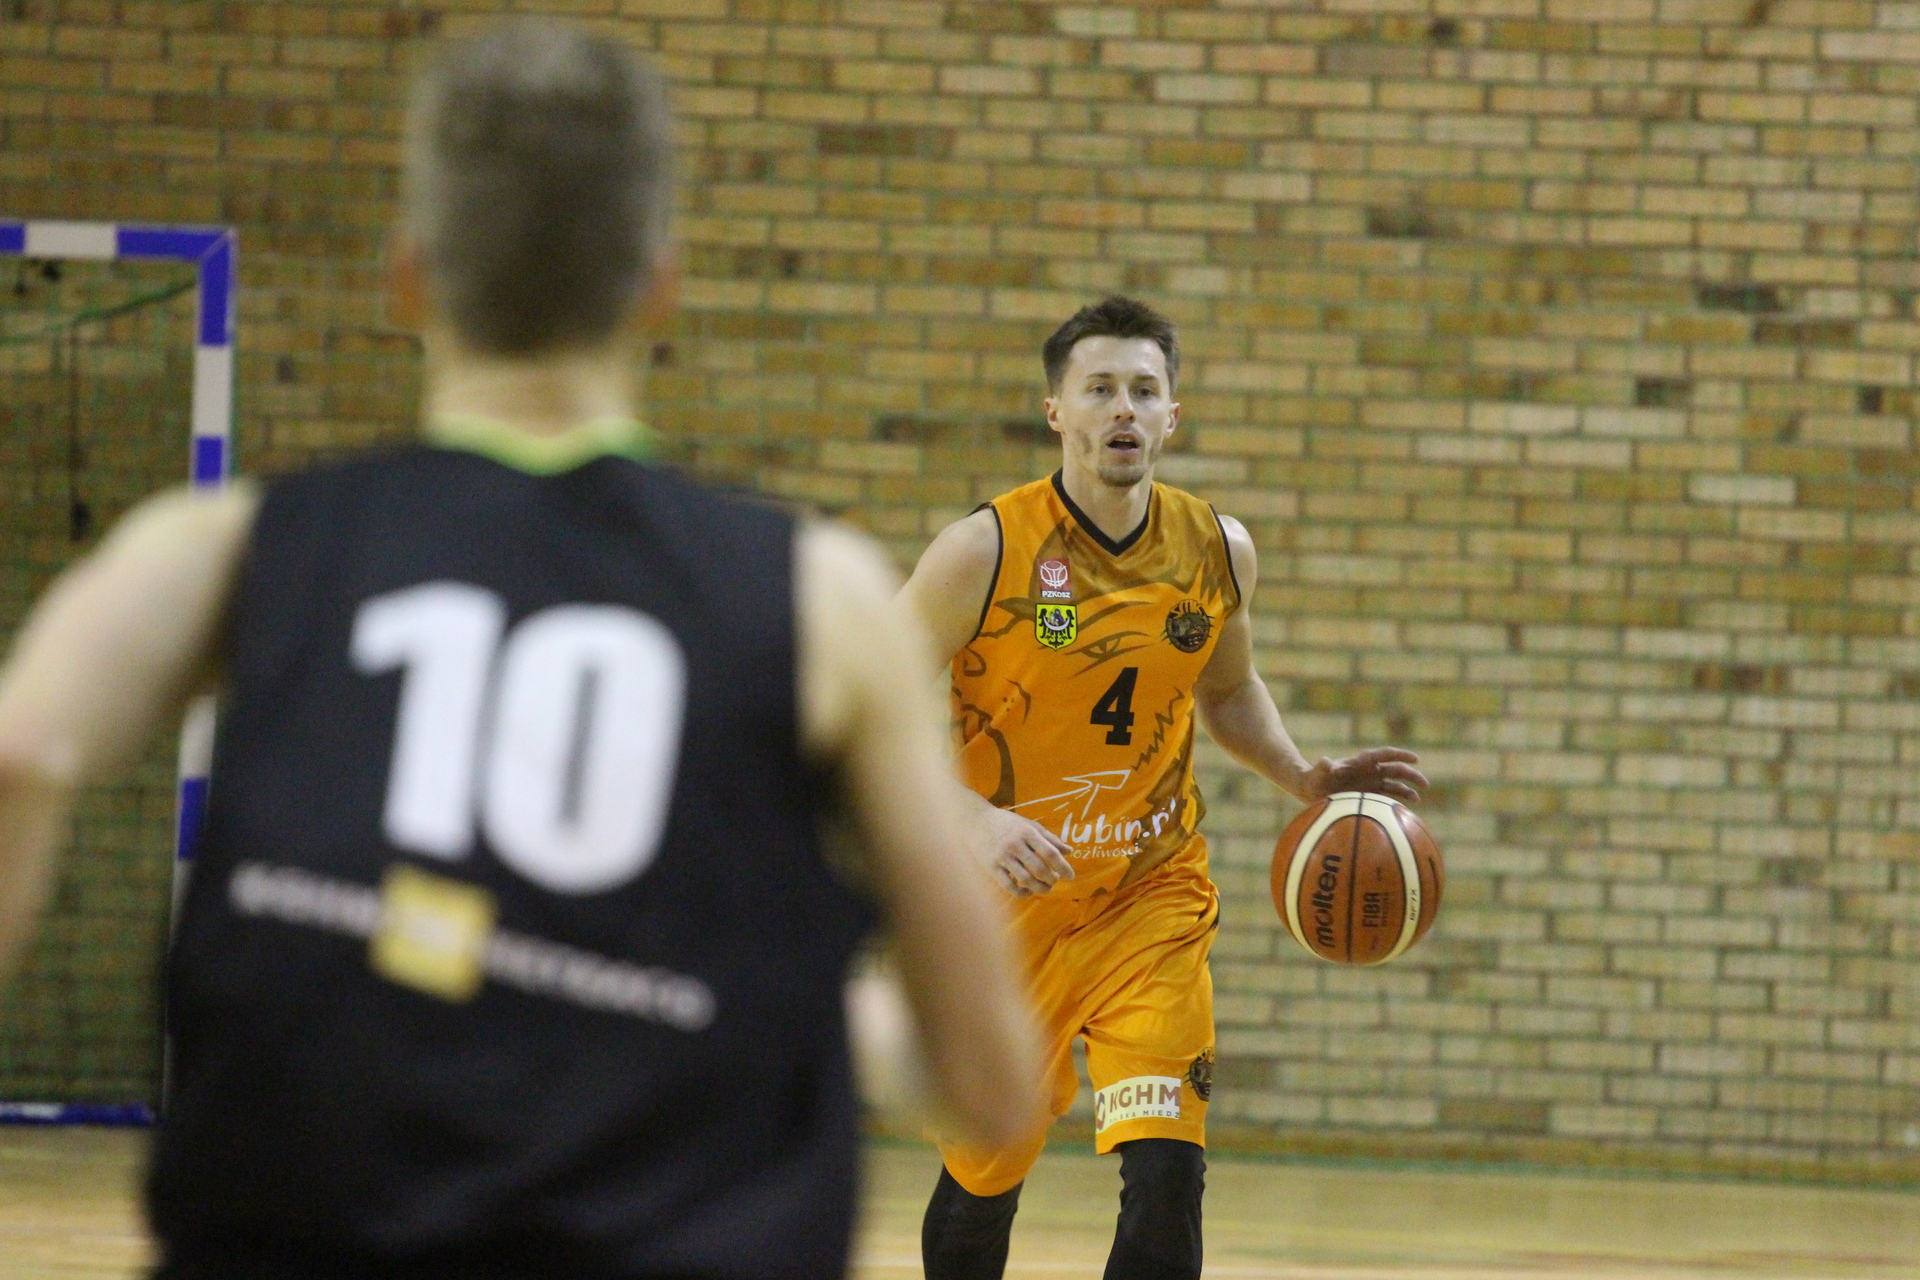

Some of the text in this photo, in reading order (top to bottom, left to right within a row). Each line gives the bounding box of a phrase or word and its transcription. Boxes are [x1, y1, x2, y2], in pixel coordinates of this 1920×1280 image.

[349, 580, 689, 894] 10
[1090, 667, 1138, 746] 4
[1311, 855, 1342, 948] molten
[1109, 1083, 1181, 1113] KGHM
